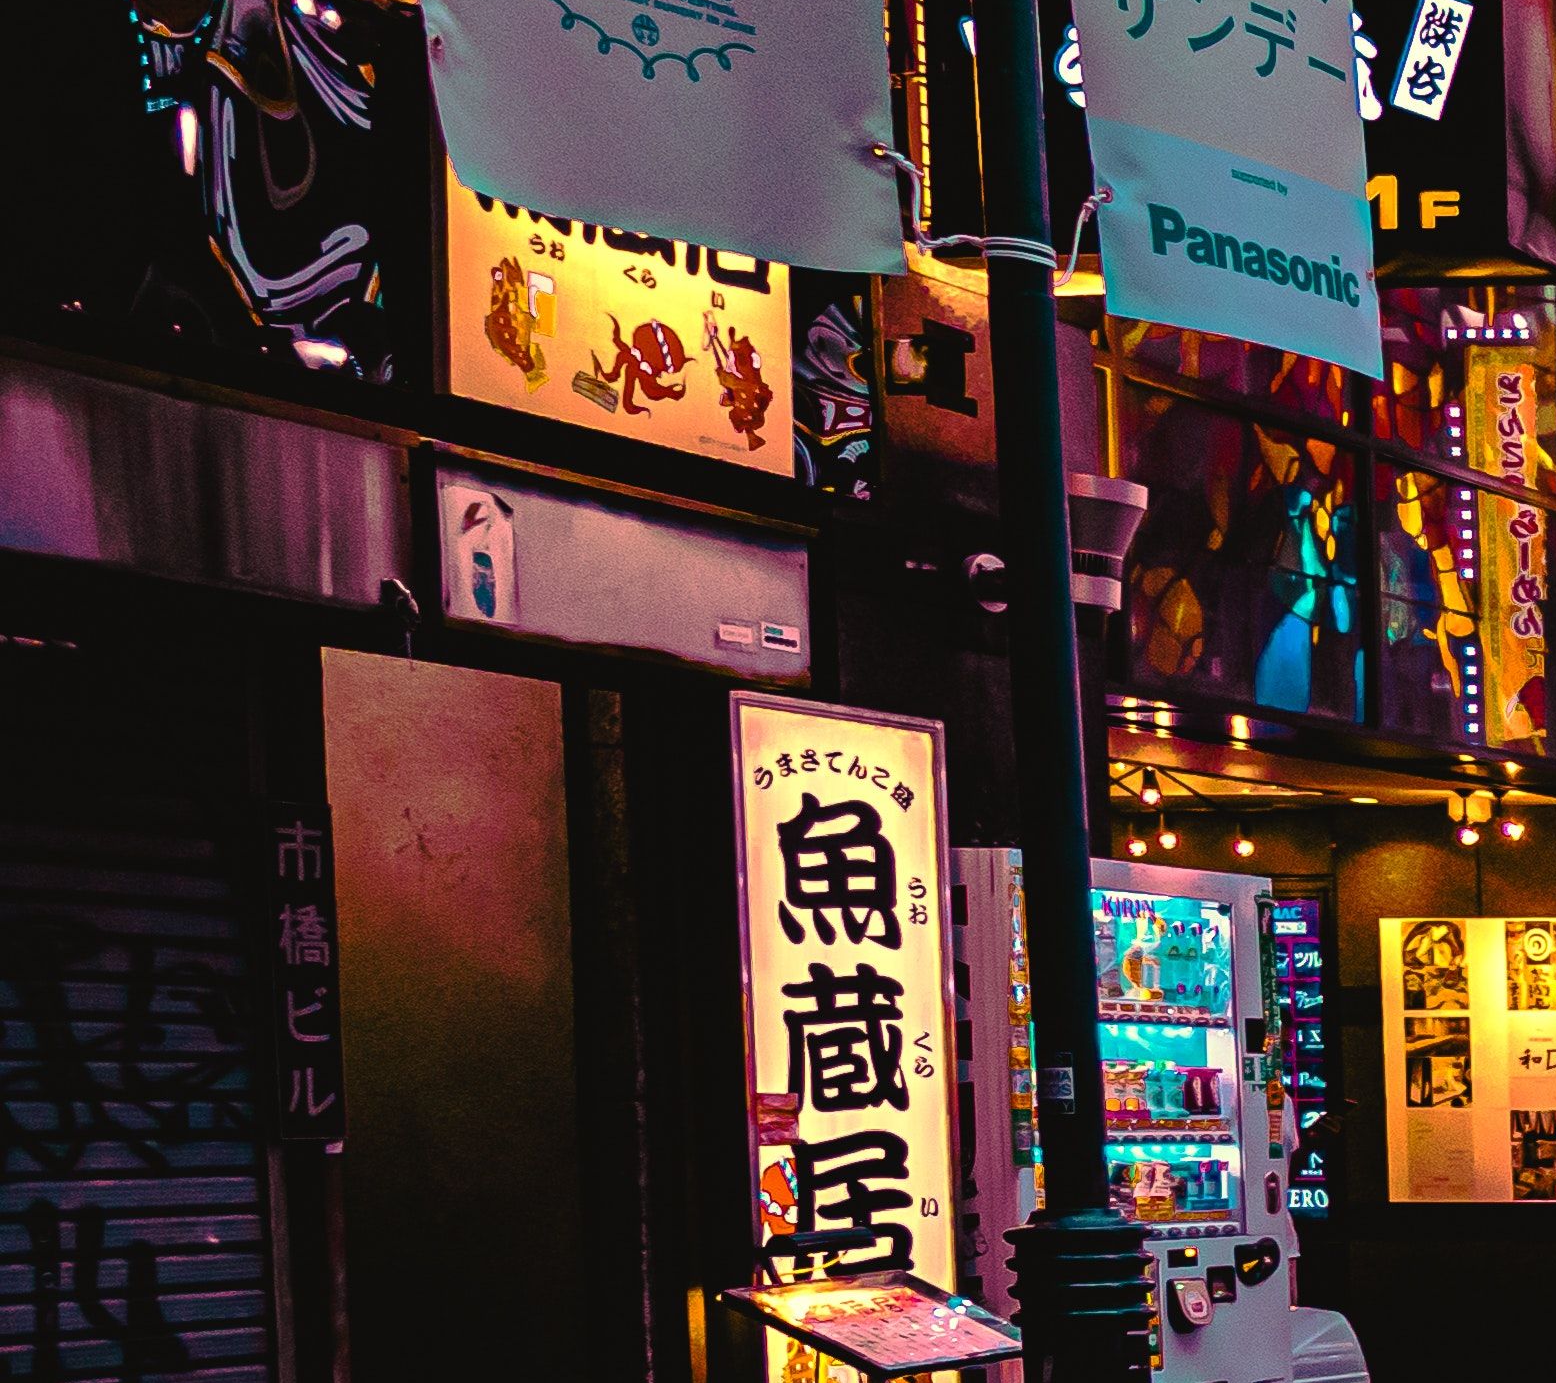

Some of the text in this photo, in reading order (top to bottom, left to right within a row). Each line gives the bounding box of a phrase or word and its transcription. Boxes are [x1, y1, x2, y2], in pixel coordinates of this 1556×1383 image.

[528, 234, 567, 263] うお
[1148, 202, 1361, 309] Panasonic
[623, 265, 659, 291] くら
[908, 876, 930, 927] うお
[1100, 895, 1156, 922] KIRIN
[275, 820, 336, 1117] 市橋ビル
[778, 792, 914, 1275] 魚蔵居
[912, 1029, 935, 1080] くら
[920, 1195, 939, 1217] い
